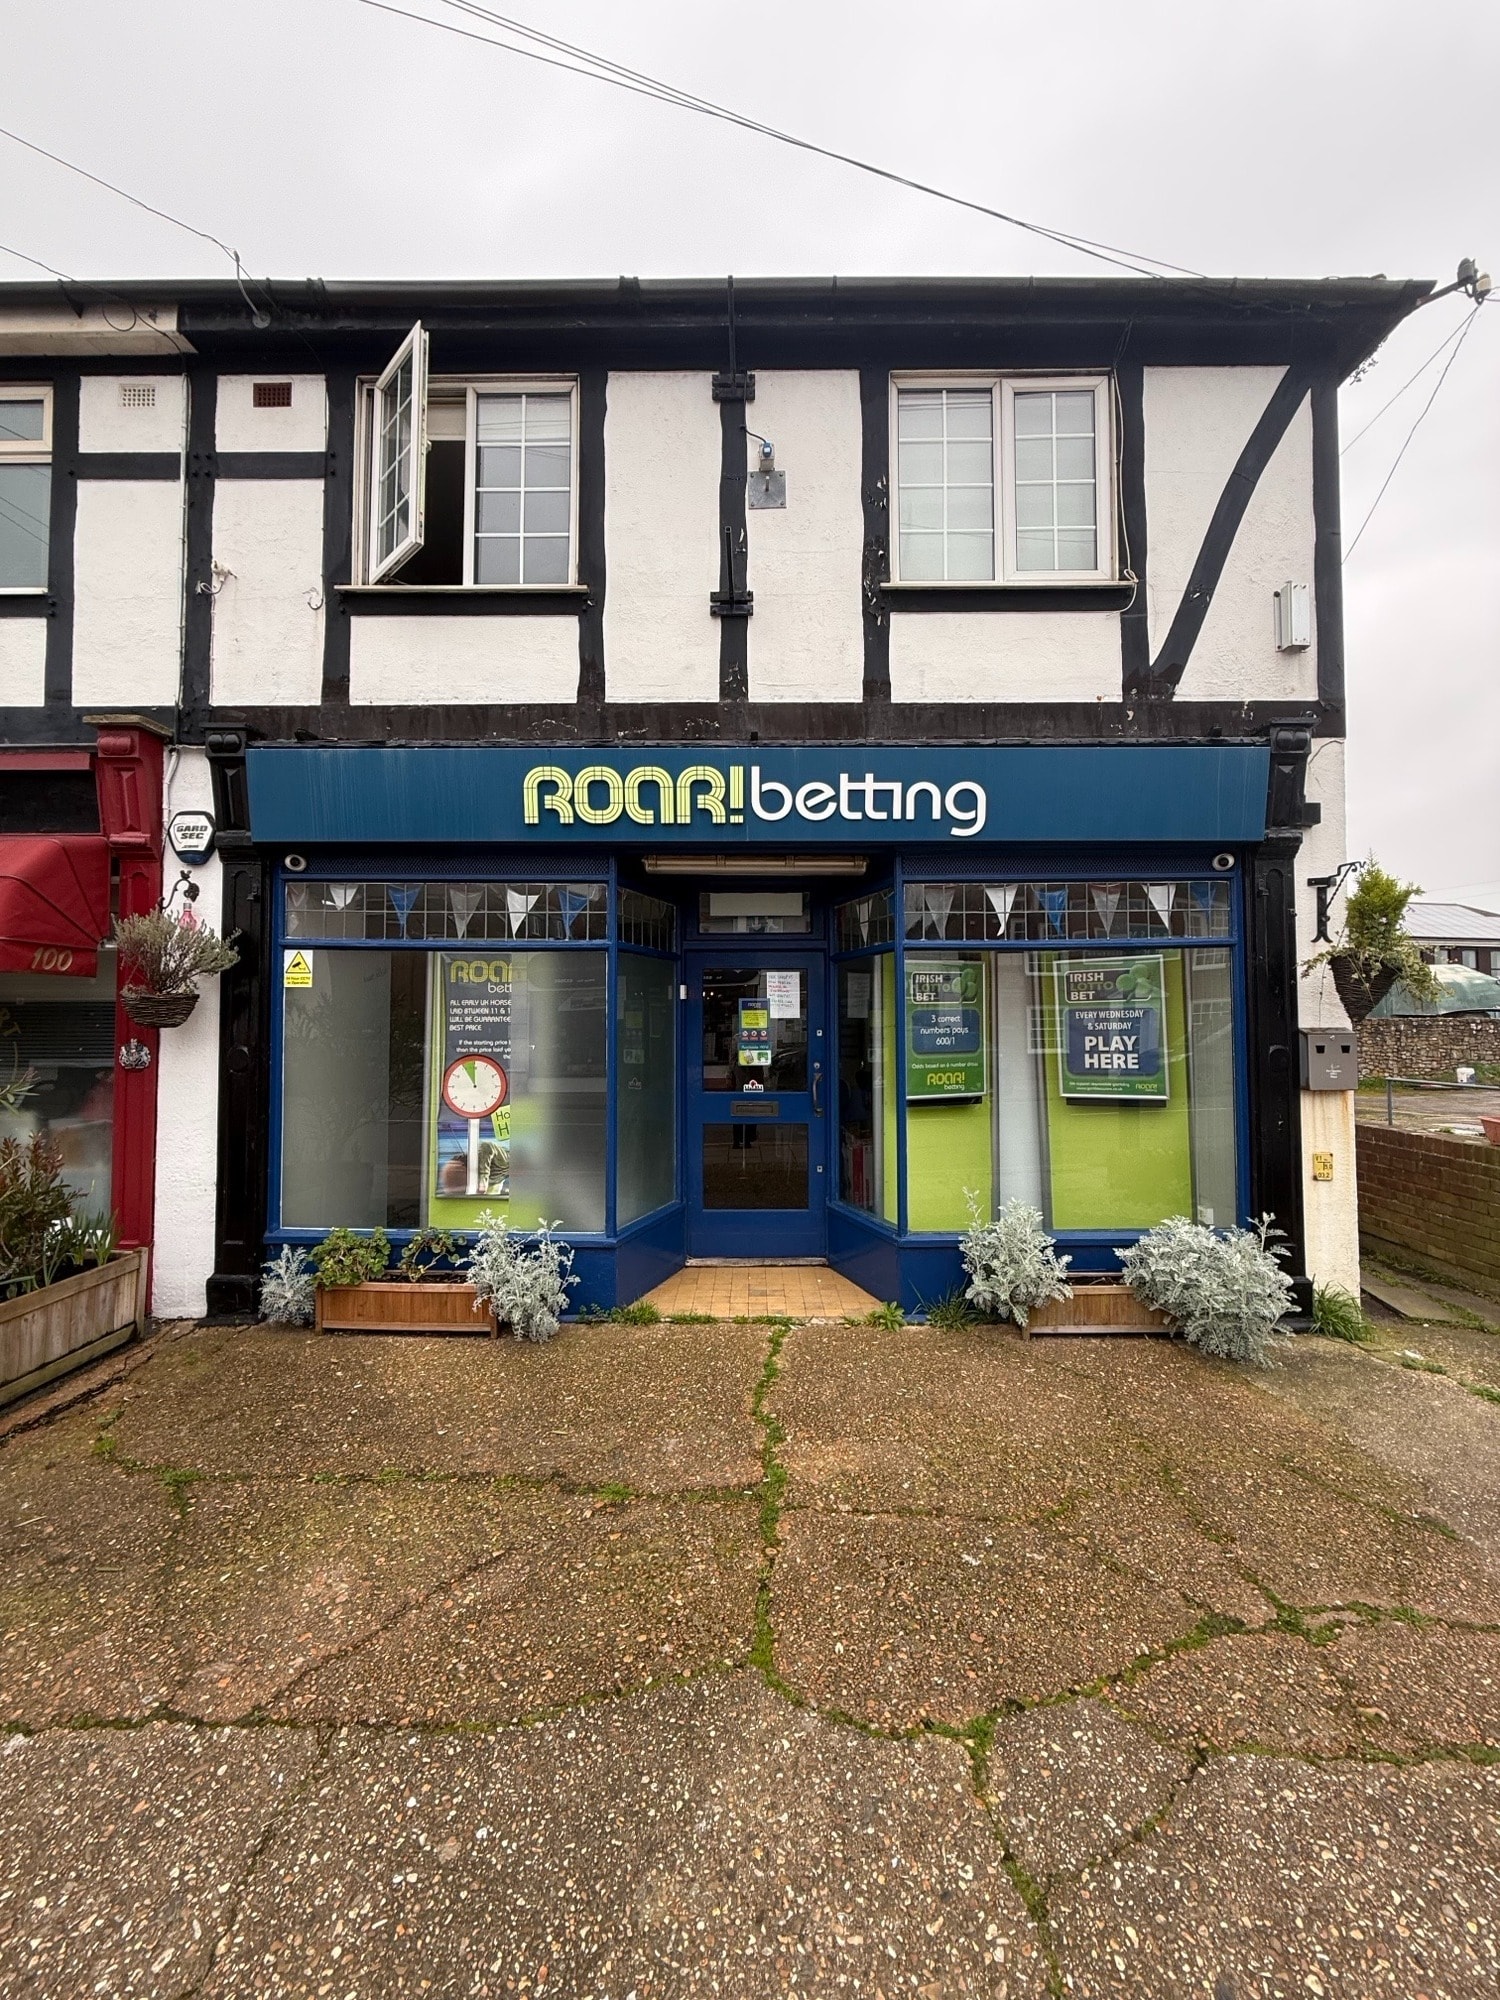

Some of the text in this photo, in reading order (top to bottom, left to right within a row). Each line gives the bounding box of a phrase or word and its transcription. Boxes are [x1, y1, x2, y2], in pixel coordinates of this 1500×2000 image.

[523, 766, 987, 837] ROAR! betting
[31, 947, 73, 971] 100
[915, 974, 944, 983] IRISH
[1069, 972, 1104, 983] IRISH
[915, 983, 951, 993] LOTTO
[1070, 981, 1114, 991] LOTTO
[915, 992, 936, 1002] BET
[1070, 990, 1096, 1001] BET
[931, 1015, 936, 1023] 3
[1075, 1009, 1144, 1019] EVERY WEDNESDAY
[920, 1026, 969, 1036] numbers pays
[1087, 1022, 1132, 1031] & SATURDAY
[935, 1037, 955, 1046] 600/1
[1084, 1035, 1138, 1052] PLAY
[1084, 1053, 1140, 1069] HERE
[927, 1072, 965, 1086] ROAR!
